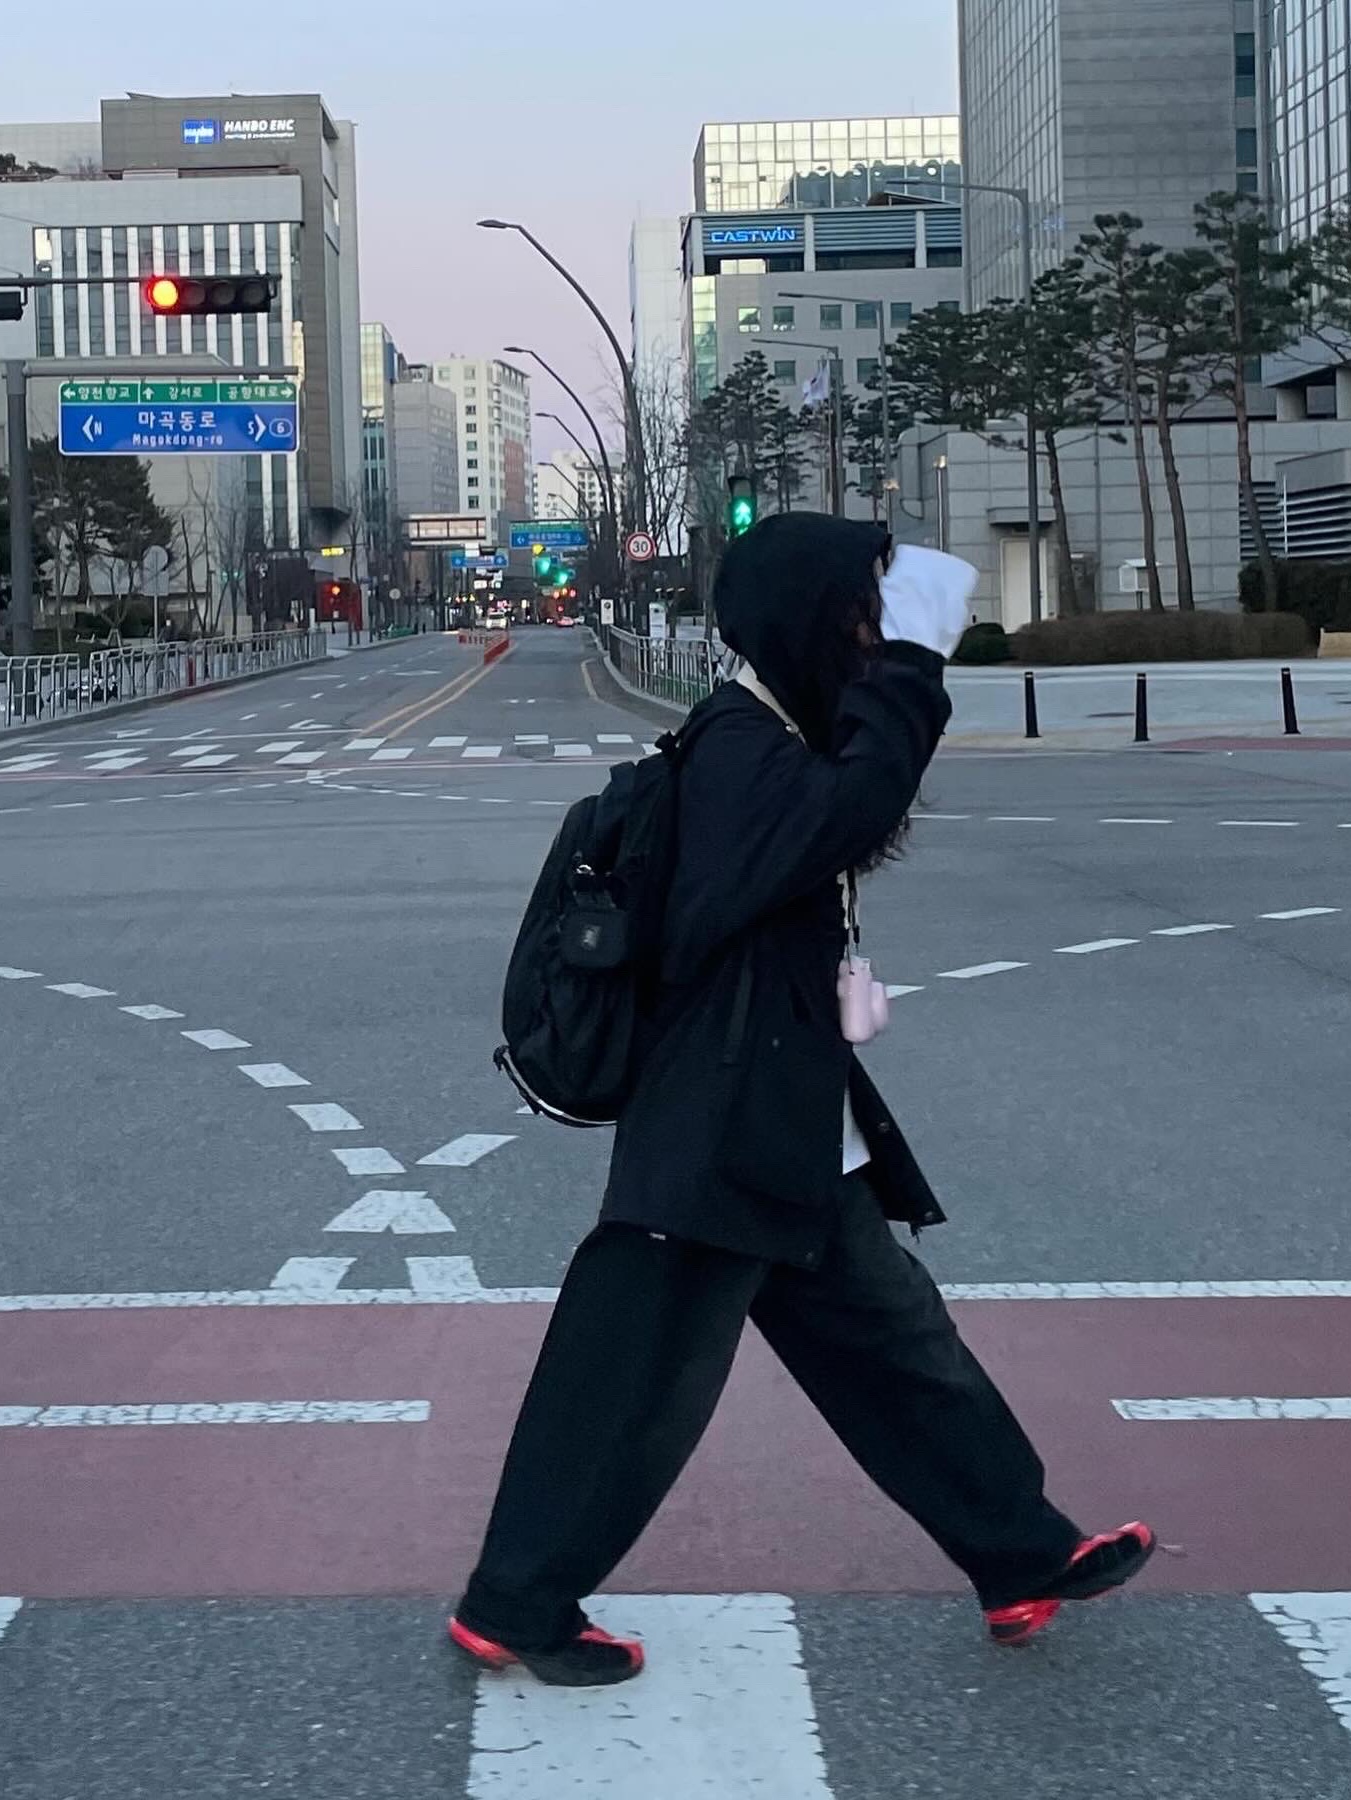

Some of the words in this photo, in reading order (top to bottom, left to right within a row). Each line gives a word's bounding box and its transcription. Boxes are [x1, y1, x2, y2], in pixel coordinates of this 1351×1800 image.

[224, 120, 268, 132] HANBO
[269, 119, 295, 131] ENC
[78, 386, 130, 400] 양천향교
[168, 386, 203, 400] 강서로
[227, 386, 279, 400] 공항대로
[94, 421, 103, 436] N
[138, 411, 217, 432] 마곡동로
[247, 420, 255, 436] S
[276, 422, 286, 435] 6
[132, 433, 224, 448] Magokdong-ro
[632, 540, 649, 553] 30
